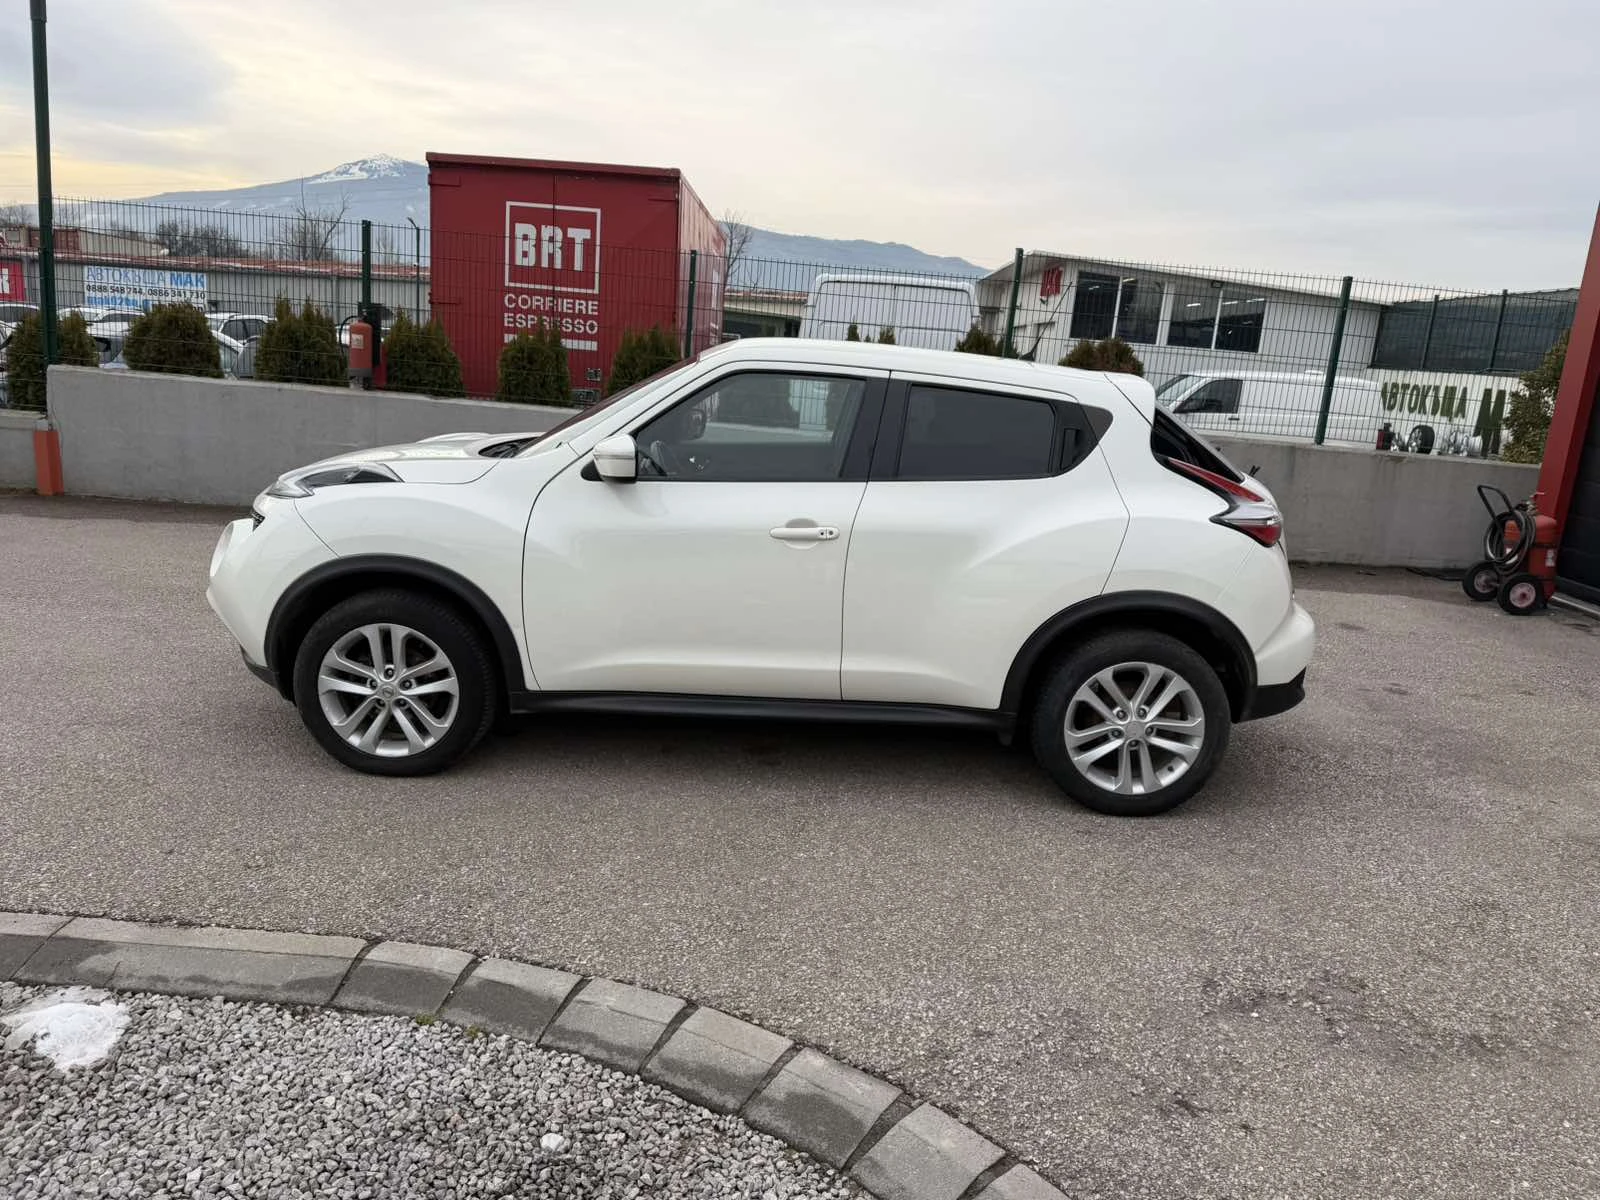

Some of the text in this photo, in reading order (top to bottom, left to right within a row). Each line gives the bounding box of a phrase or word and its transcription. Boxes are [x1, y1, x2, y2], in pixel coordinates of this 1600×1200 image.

[514, 222, 592, 272] BRT
[169, 272, 205, 288] МАК
[504, 294, 598, 315] CORRIERE
[504, 313, 598, 334] ESPRSSO
